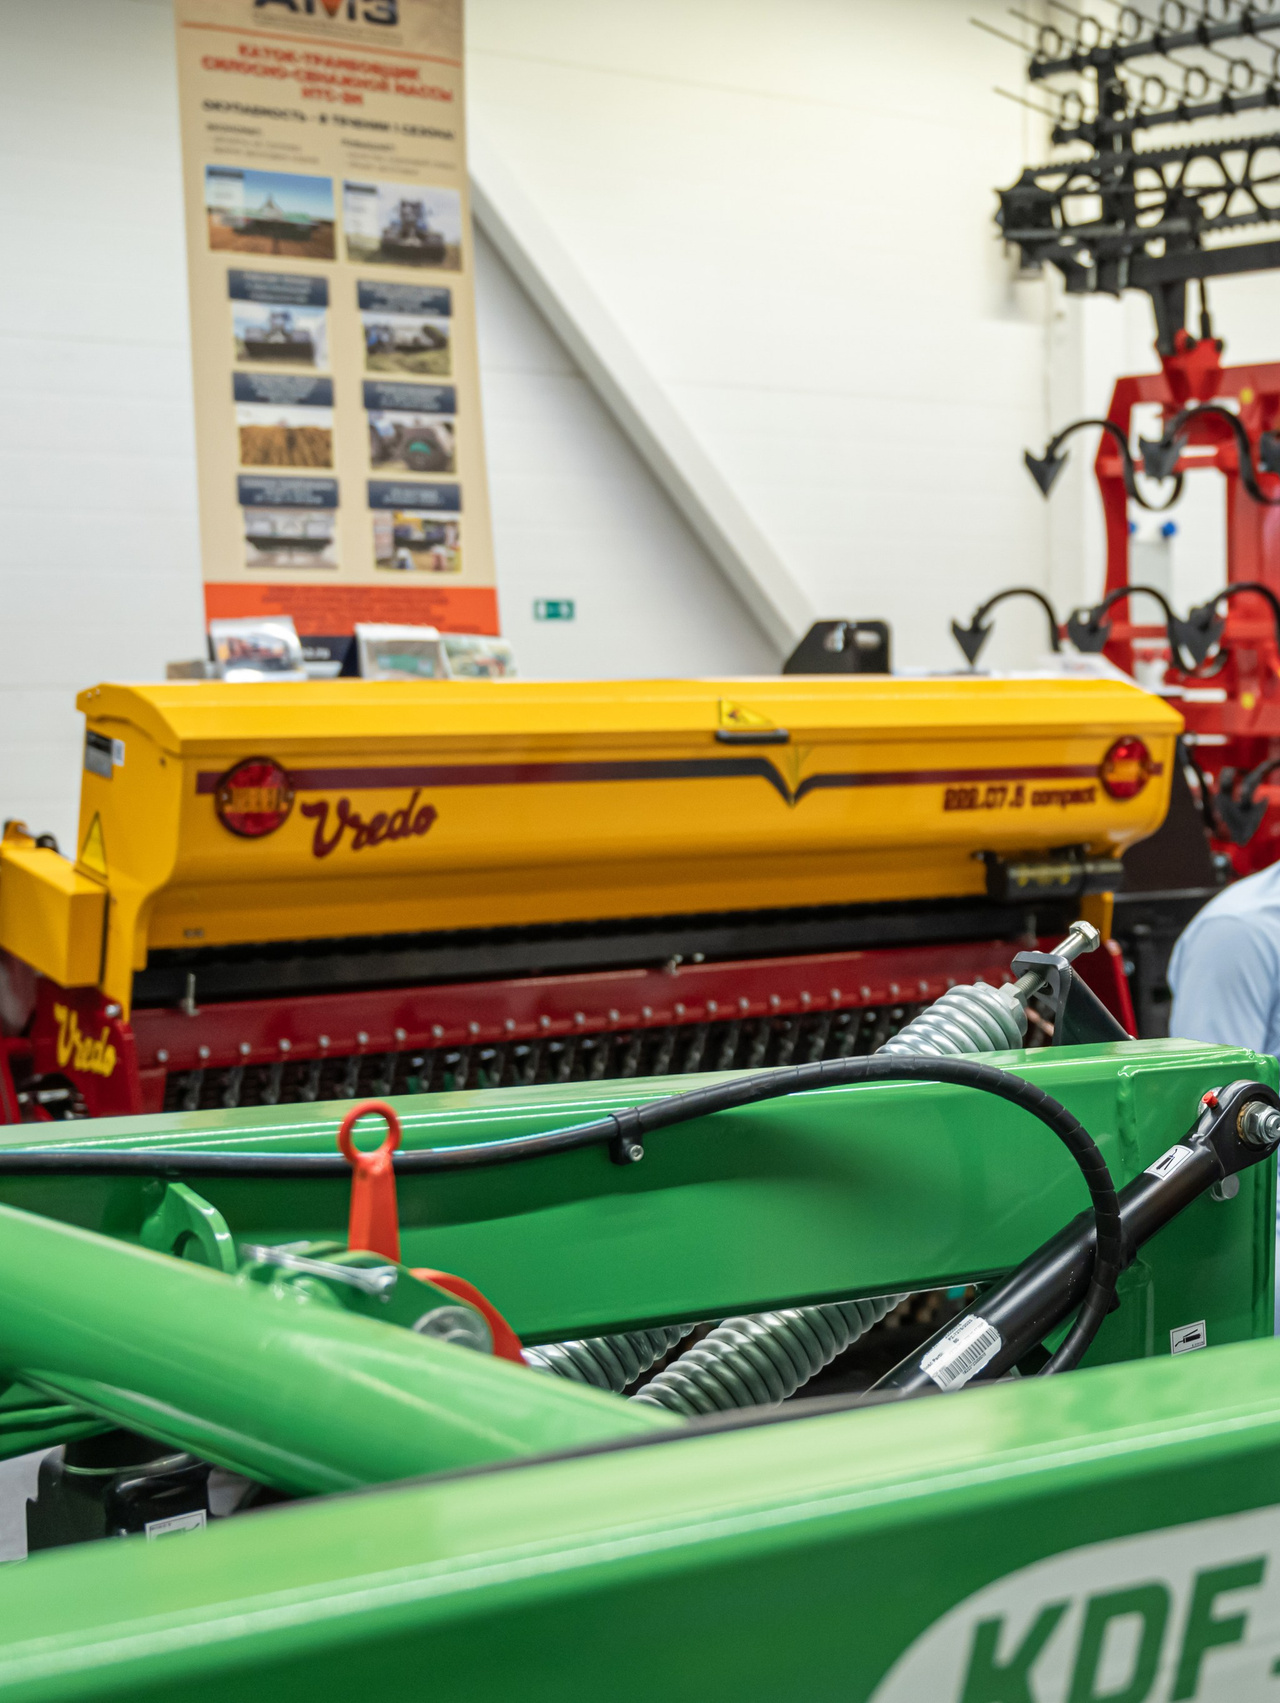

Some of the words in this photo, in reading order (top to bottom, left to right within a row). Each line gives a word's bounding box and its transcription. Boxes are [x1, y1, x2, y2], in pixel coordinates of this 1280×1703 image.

[300, 788, 438, 859] Vredo
[54, 1002, 116, 1077] Vredo
[960, 1555, 1268, 1703] KDF
